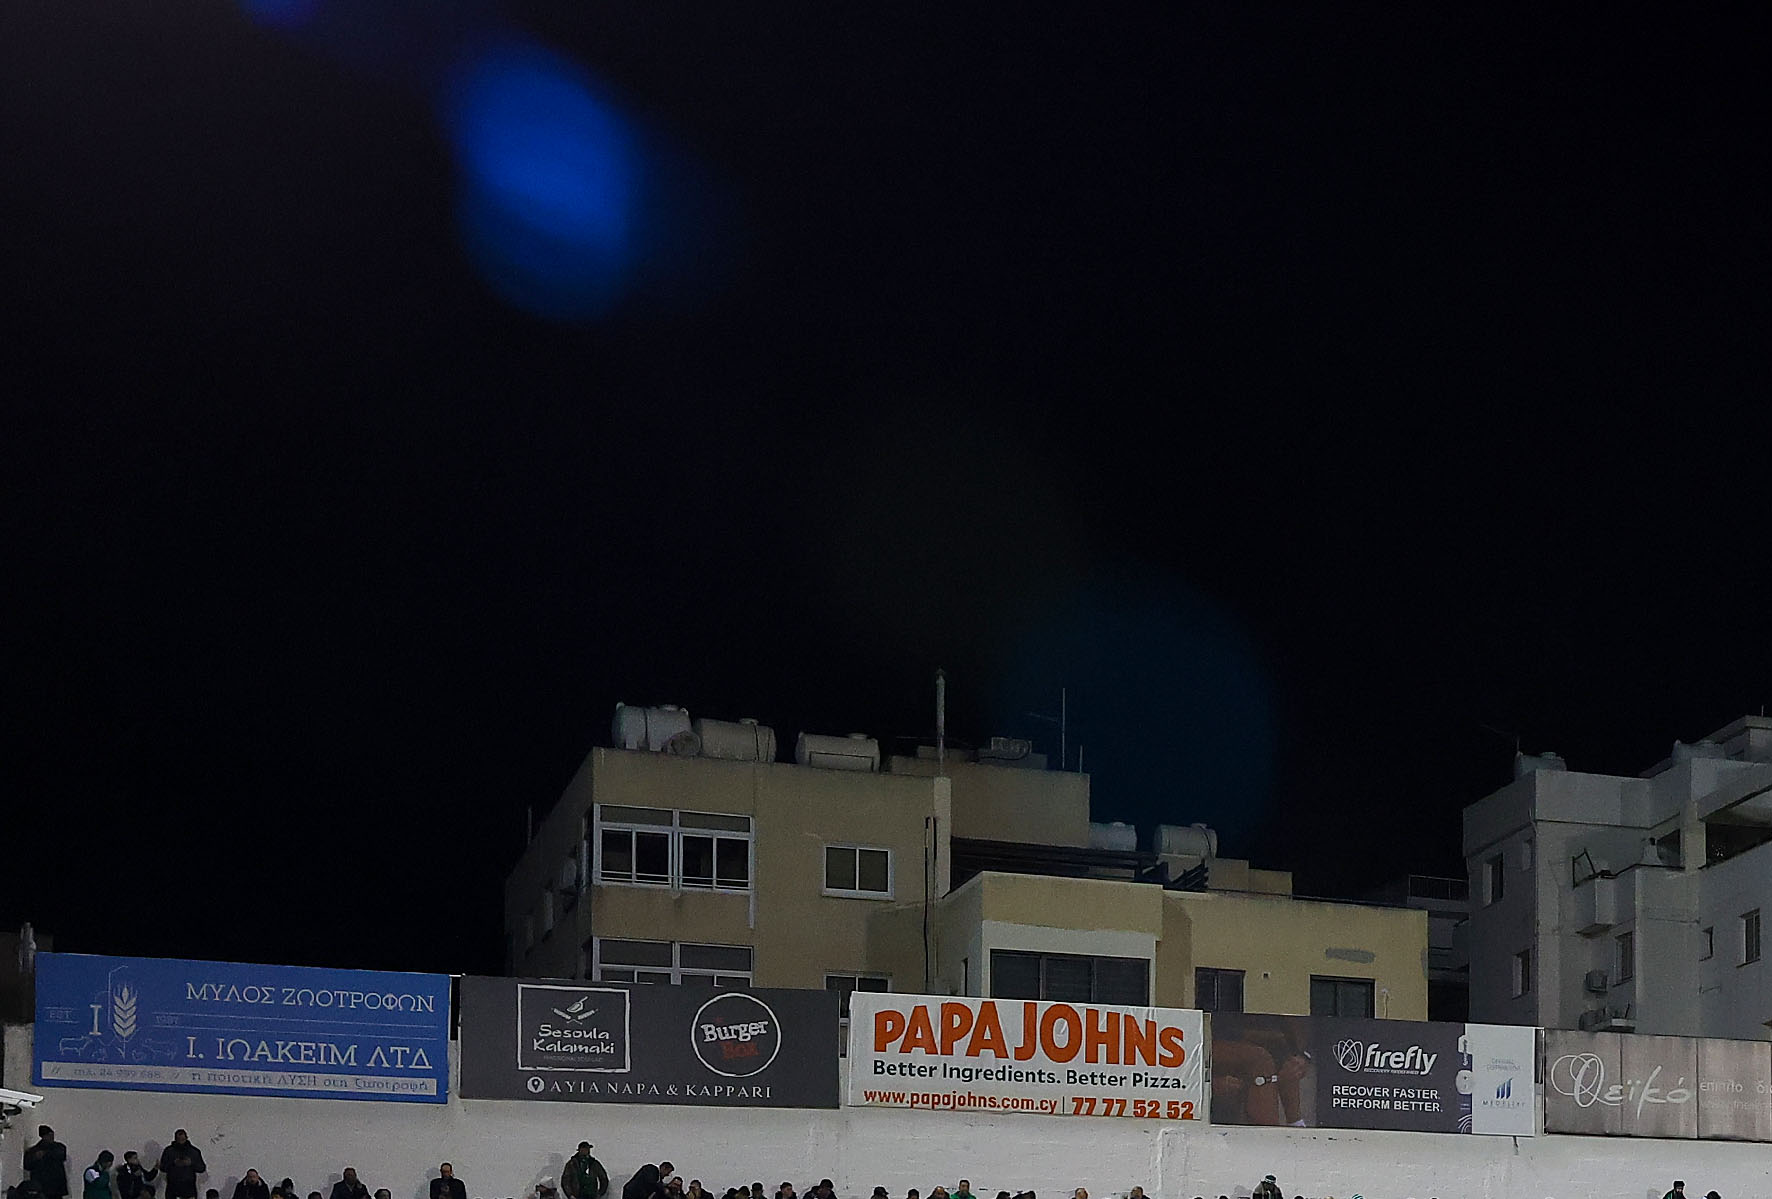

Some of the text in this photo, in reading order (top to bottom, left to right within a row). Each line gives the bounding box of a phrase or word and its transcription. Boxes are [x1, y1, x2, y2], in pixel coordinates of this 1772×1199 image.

[187, 982, 434, 1012] ΜΥΛΟΣ ΖΩΟΤΡΟΦΩΝ
[539, 1024, 610, 1040] Sesoula
[701, 1021, 769, 1042] Burger
[874, 1001, 1186, 1068] PAPA JOHNS
[216, 1038, 357, 1066] ΙΩΑΚΕΙΜ
[367, 1046, 432, 1069] ΛΤΔ
[532, 1039, 615, 1055] Kalamaki
[1365, 1044, 1438, 1075] firefly
[873, 1059, 1187, 1090] Better Ingredients. Better Pizza.
[550, 1081, 772, 1098] AYIA NAPA & KAPPARI
[1332, 1085, 1441, 1100] RECOVER FASTER.
[863, 1089, 1194, 1120] www.papajohns.com.cy 77 77 52 52
[1332, 1098, 1444, 1113] PERFORM BETTER.
